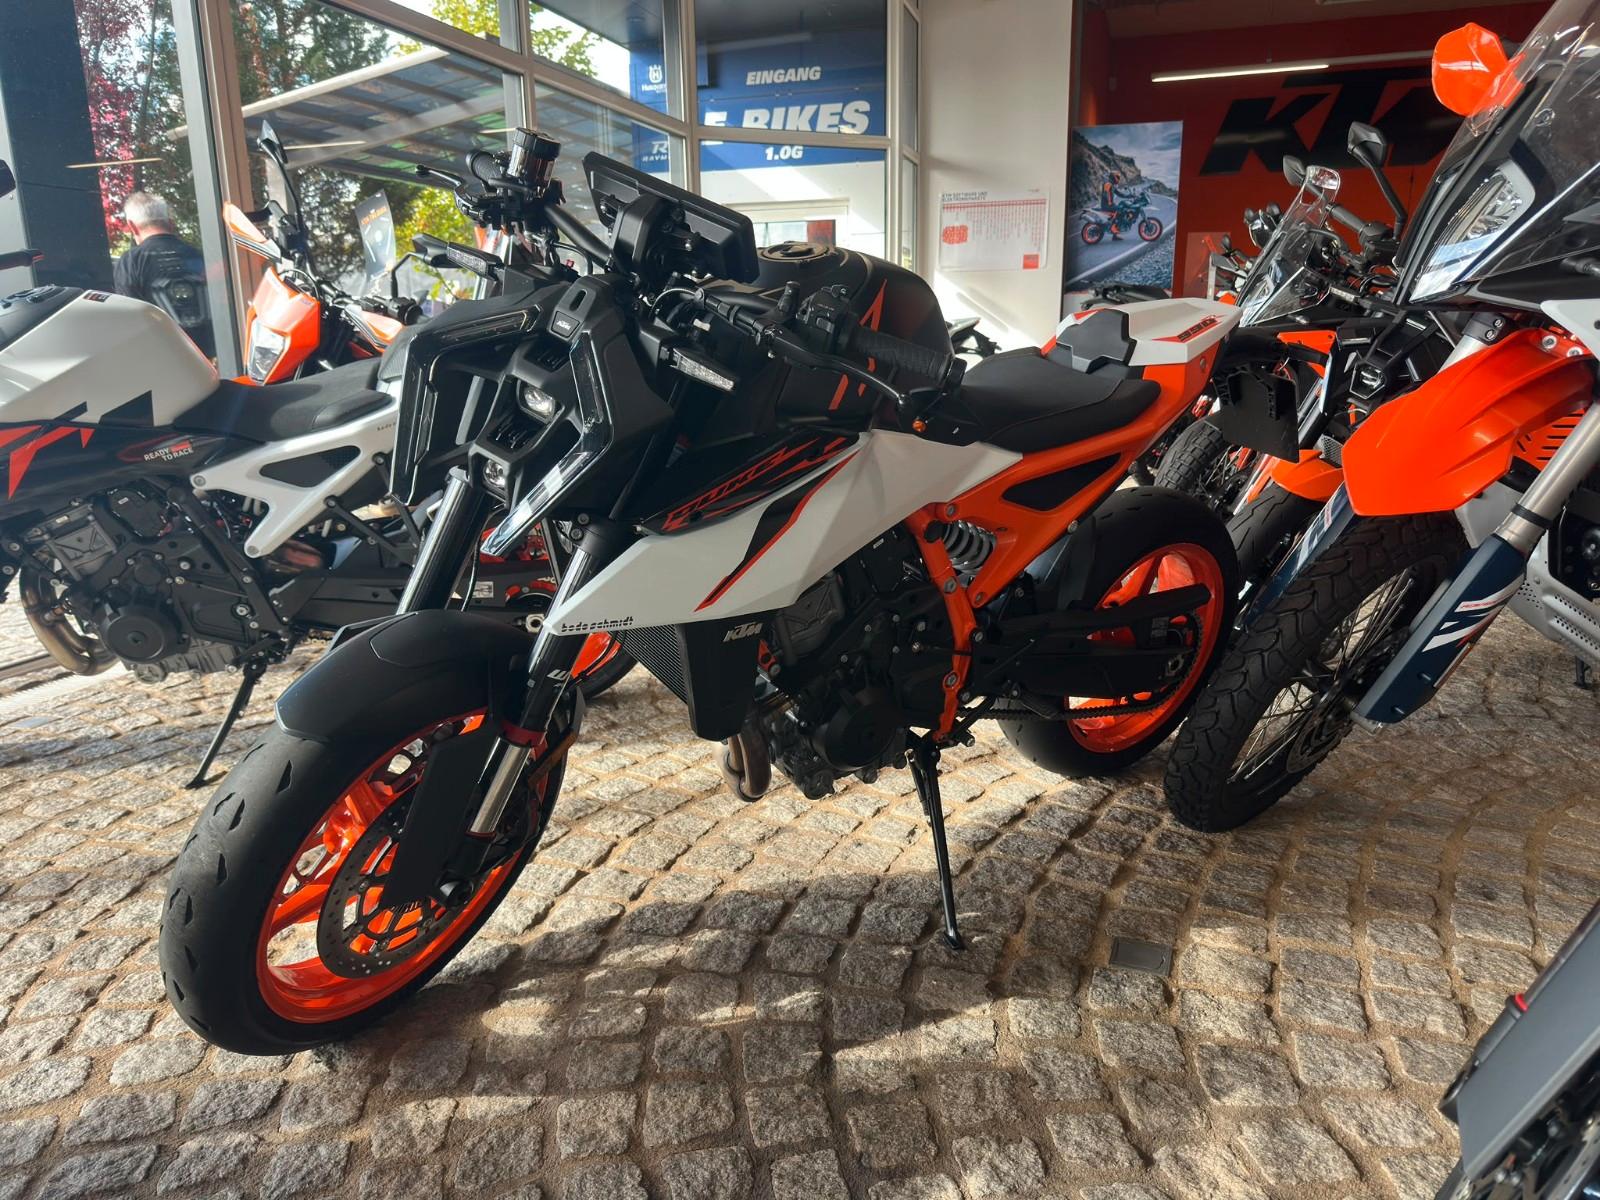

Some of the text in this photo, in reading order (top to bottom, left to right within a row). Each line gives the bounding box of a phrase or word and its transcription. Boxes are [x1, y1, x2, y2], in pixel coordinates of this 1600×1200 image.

[746, 66, 822, 86] EINGANG
[742, 100, 871, 135] BIKES
[642, 154, 668, 162] RAYM
[765, 145, 803, 160] 1.0G
[143, 447, 170, 461] READY
[172, 447, 194, 458] RACE
[561, 616, 634, 632] bodo schmidt
[723, 622, 764, 642] KTM
